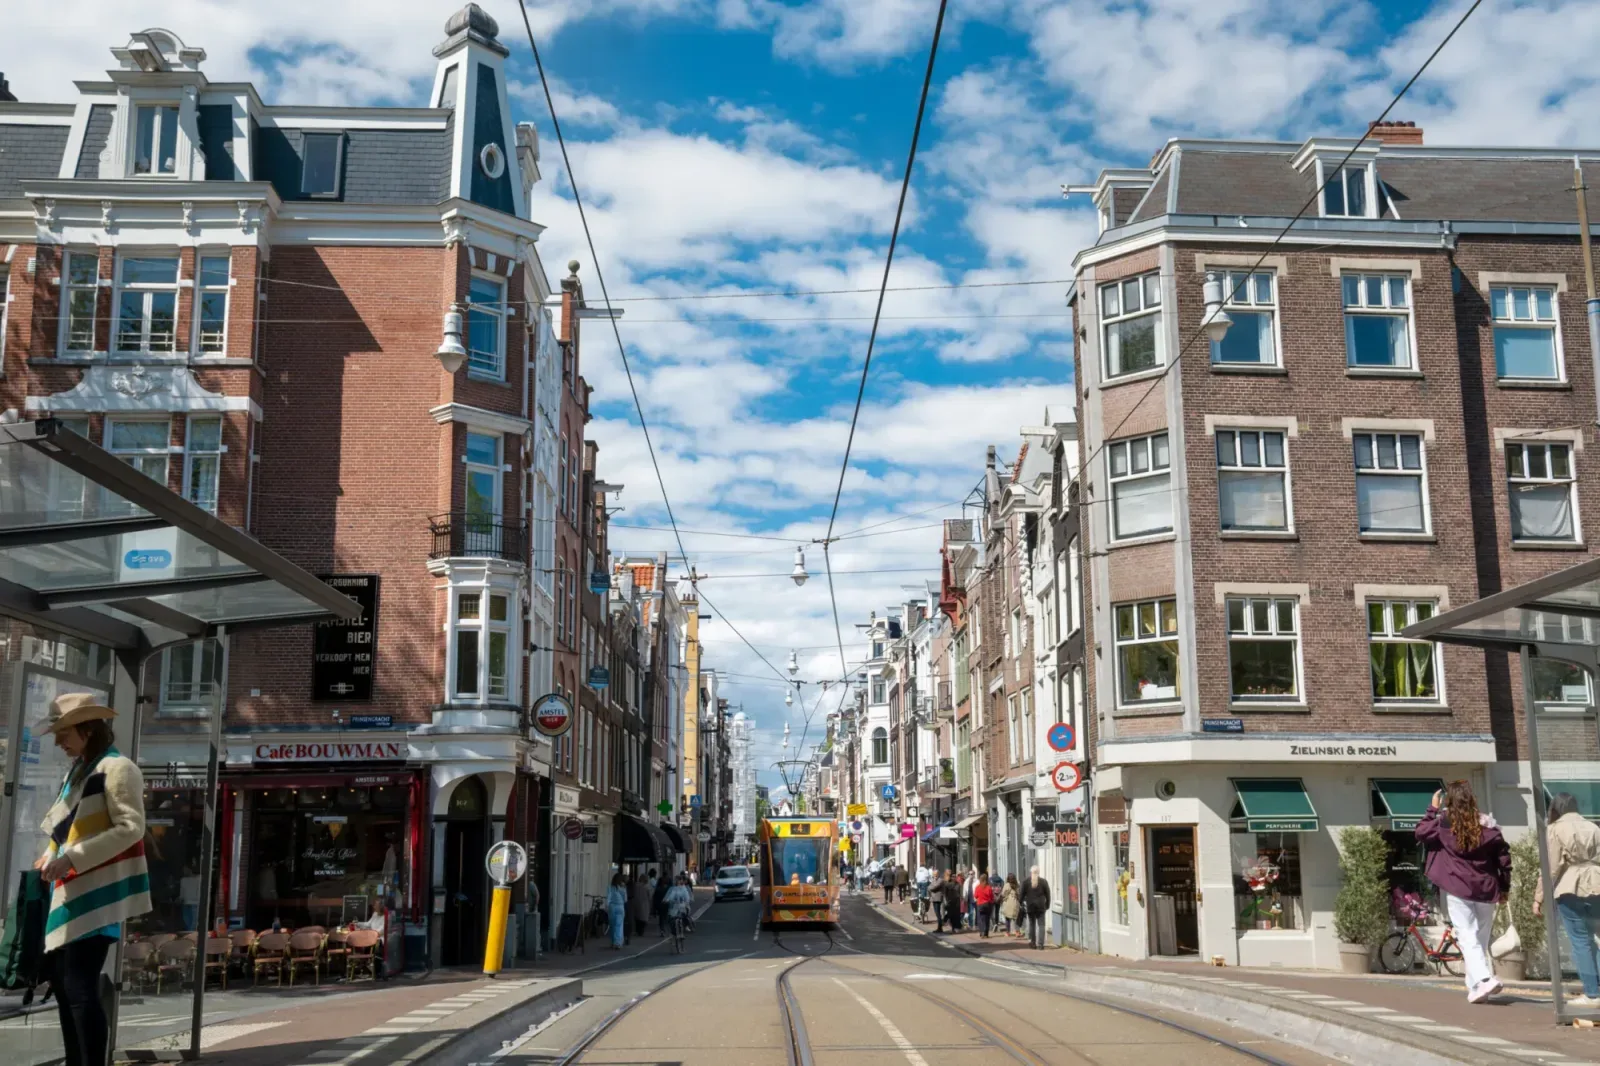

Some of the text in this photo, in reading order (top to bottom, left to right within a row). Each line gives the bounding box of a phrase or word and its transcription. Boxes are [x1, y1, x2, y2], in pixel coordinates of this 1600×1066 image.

[347, 632, 371, 643] BIER
[316, 653, 370, 662] VERKOOPT MEN
[353, 666, 370, 674] HIER
[255, 743, 400, 759] Café BOUWMAN
[1290, 745, 1397, 756] ZIELINSKI & ROZEN
[152, 780, 209, 789] BOUWMA
[1035, 812, 1055, 821] KAJA
[797, 823, 803, 831] 4
[1056, 828, 1079, 844] hotel
